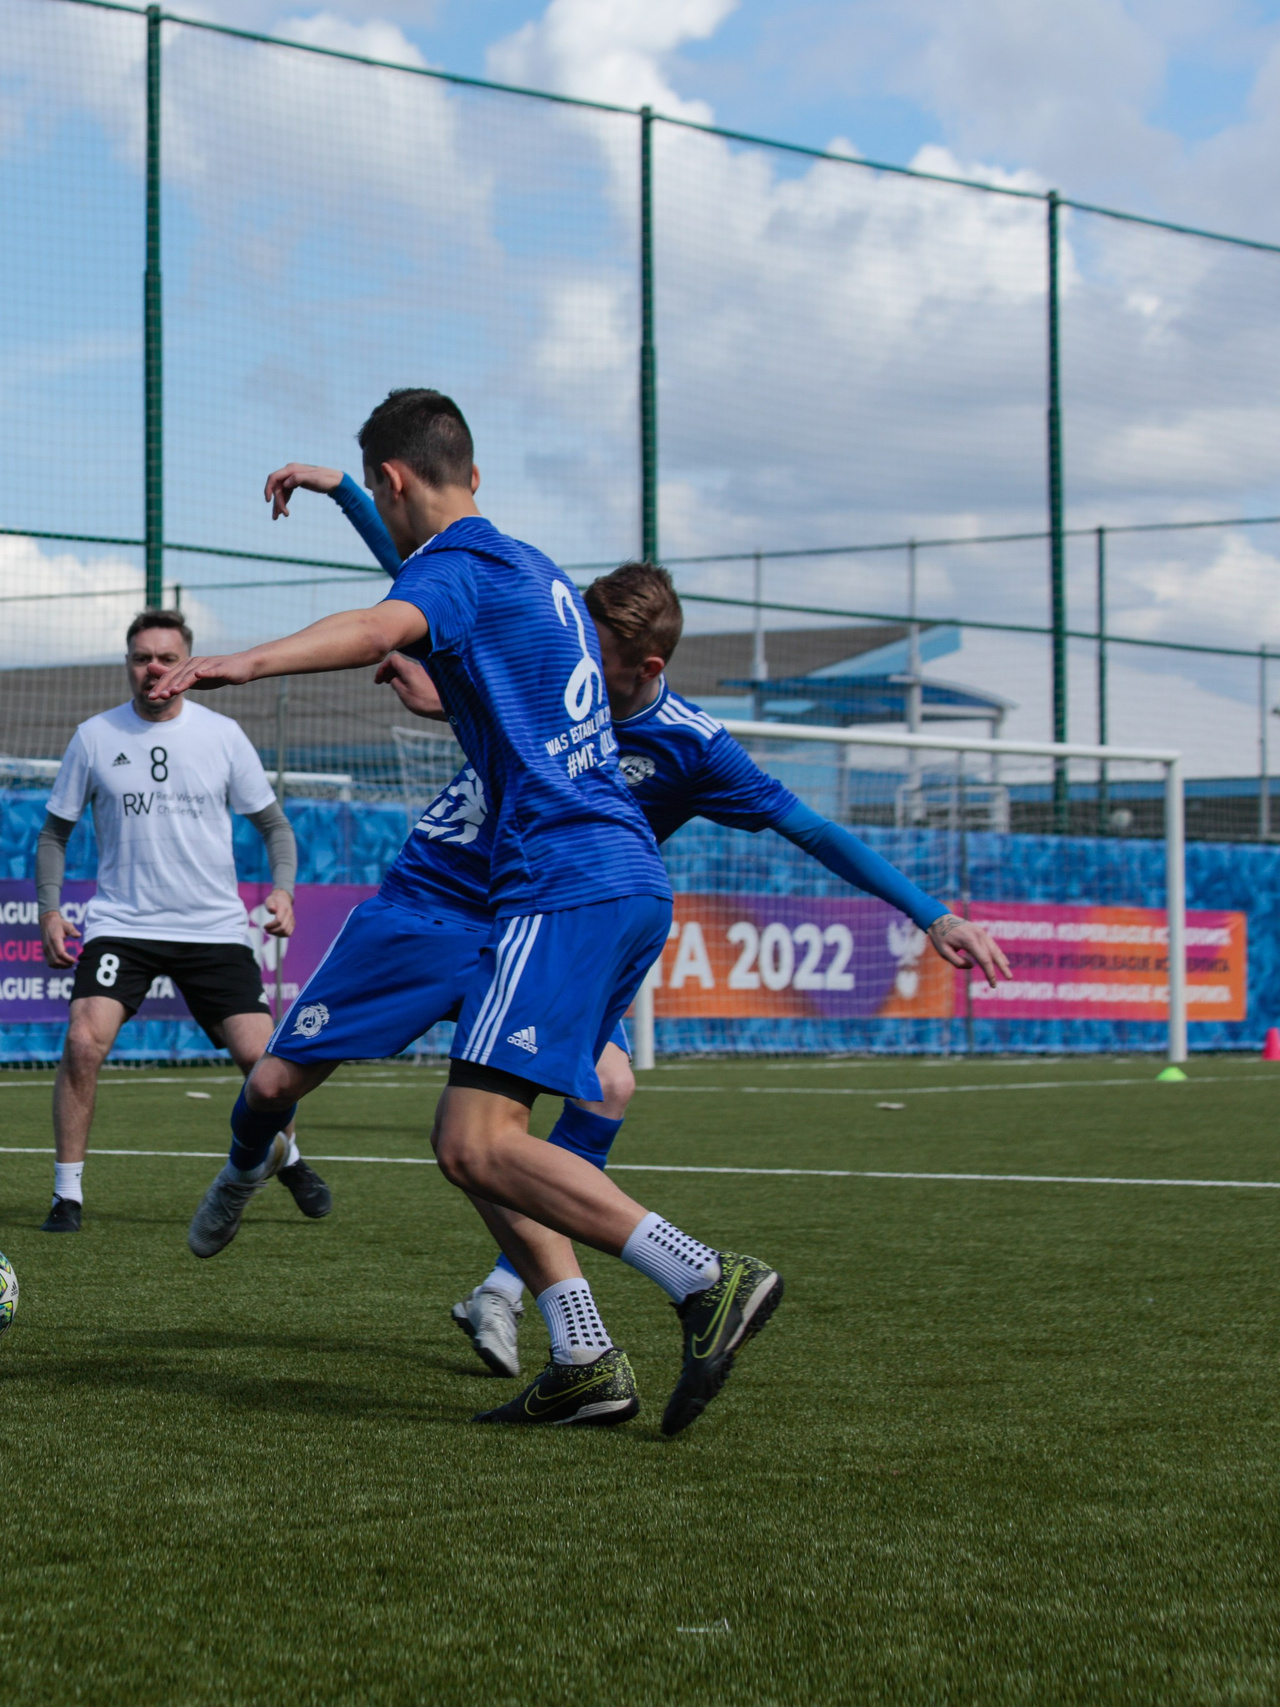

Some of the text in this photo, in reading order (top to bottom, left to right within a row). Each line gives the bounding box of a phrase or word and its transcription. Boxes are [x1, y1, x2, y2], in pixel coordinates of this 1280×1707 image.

[545, 733, 569, 757] WAS
[150, 746, 168, 783] 8
[96, 953, 120, 988] 8
[726, 921, 855, 991] 2022
[506, 1035, 539, 1055] adidas
